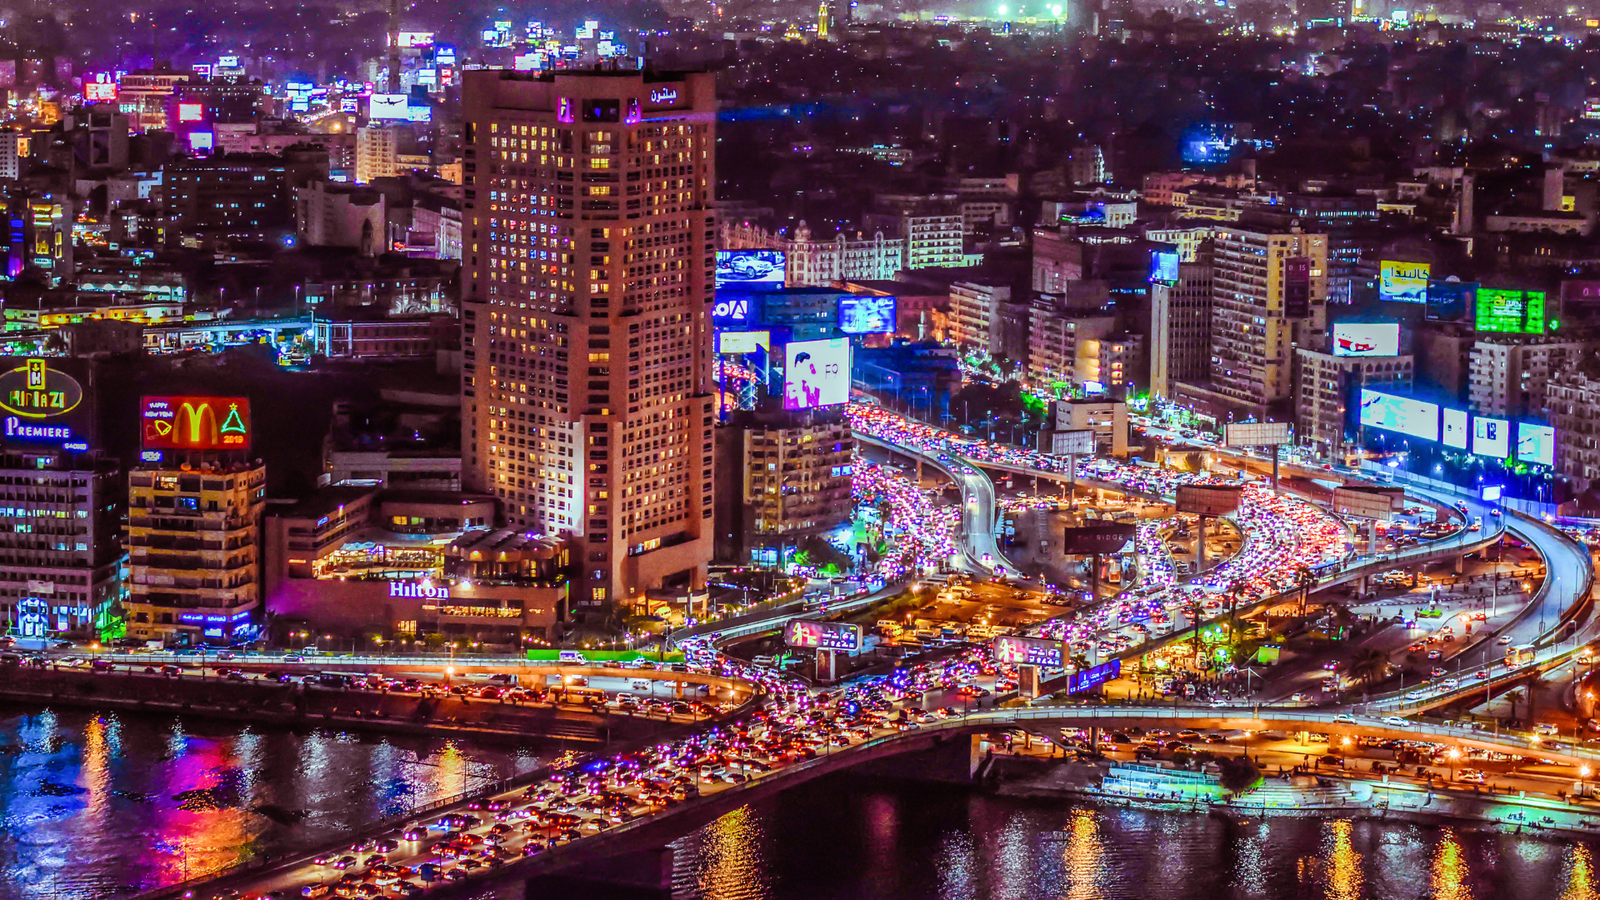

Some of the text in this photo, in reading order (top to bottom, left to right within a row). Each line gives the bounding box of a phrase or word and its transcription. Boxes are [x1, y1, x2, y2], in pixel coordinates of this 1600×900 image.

[651, 87, 677, 104] هيلتون
[223, 435, 244, 443] 2019
[390, 581, 449, 598] Hilton
